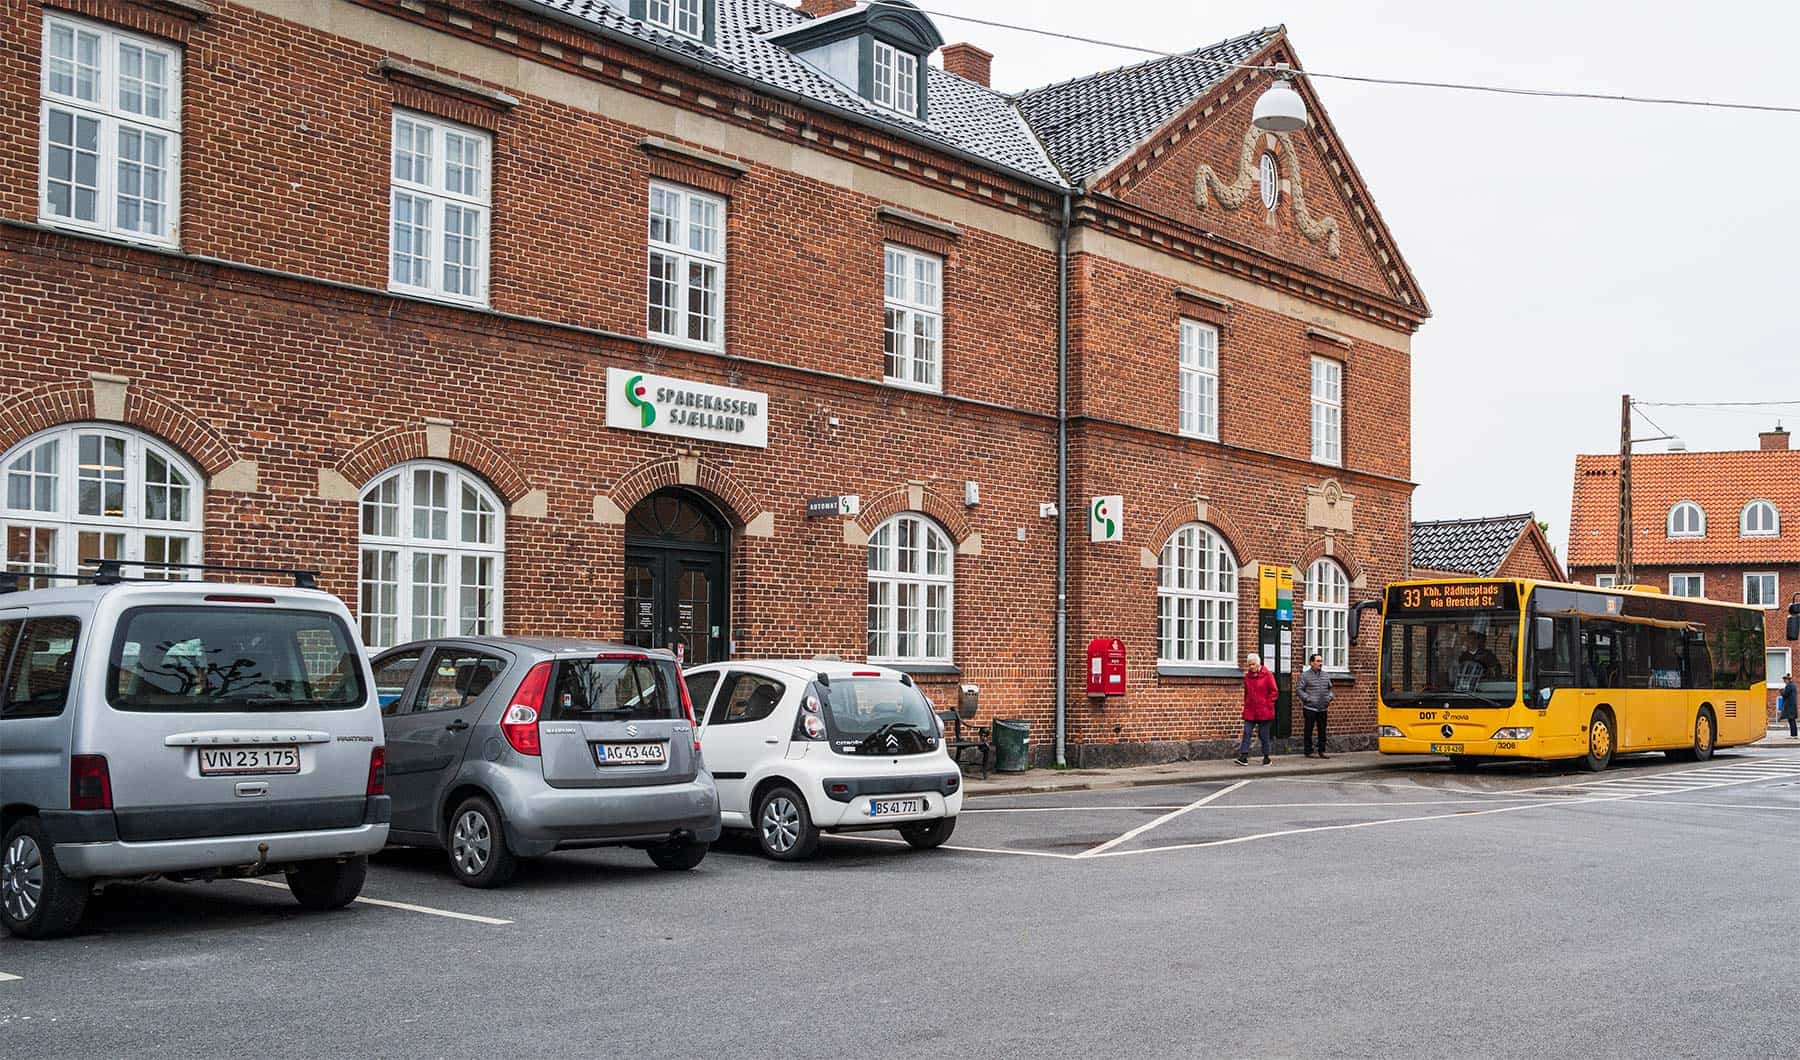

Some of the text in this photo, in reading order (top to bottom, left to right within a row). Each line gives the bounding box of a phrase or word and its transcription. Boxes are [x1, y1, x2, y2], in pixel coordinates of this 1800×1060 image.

[656, 387, 758, 416] SPAREKASSEN
[669, 408, 745, 433] SJÆLLAND
[810, 502, 838, 510] AUTOMAT
[1423, 584, 1499, 597] Kbh. Rådhusplads
[1403, 589, 1421, 607] 33
[1431, 595, 1495, 607] via Ørestad St.
[191, 735, 313, 743] PEUGEOT
[607, 745, 662, 759] AG 43 443
[205, 751, 294, 767] VN 23 175
[876, 801, 917, 814] BS 41 771
